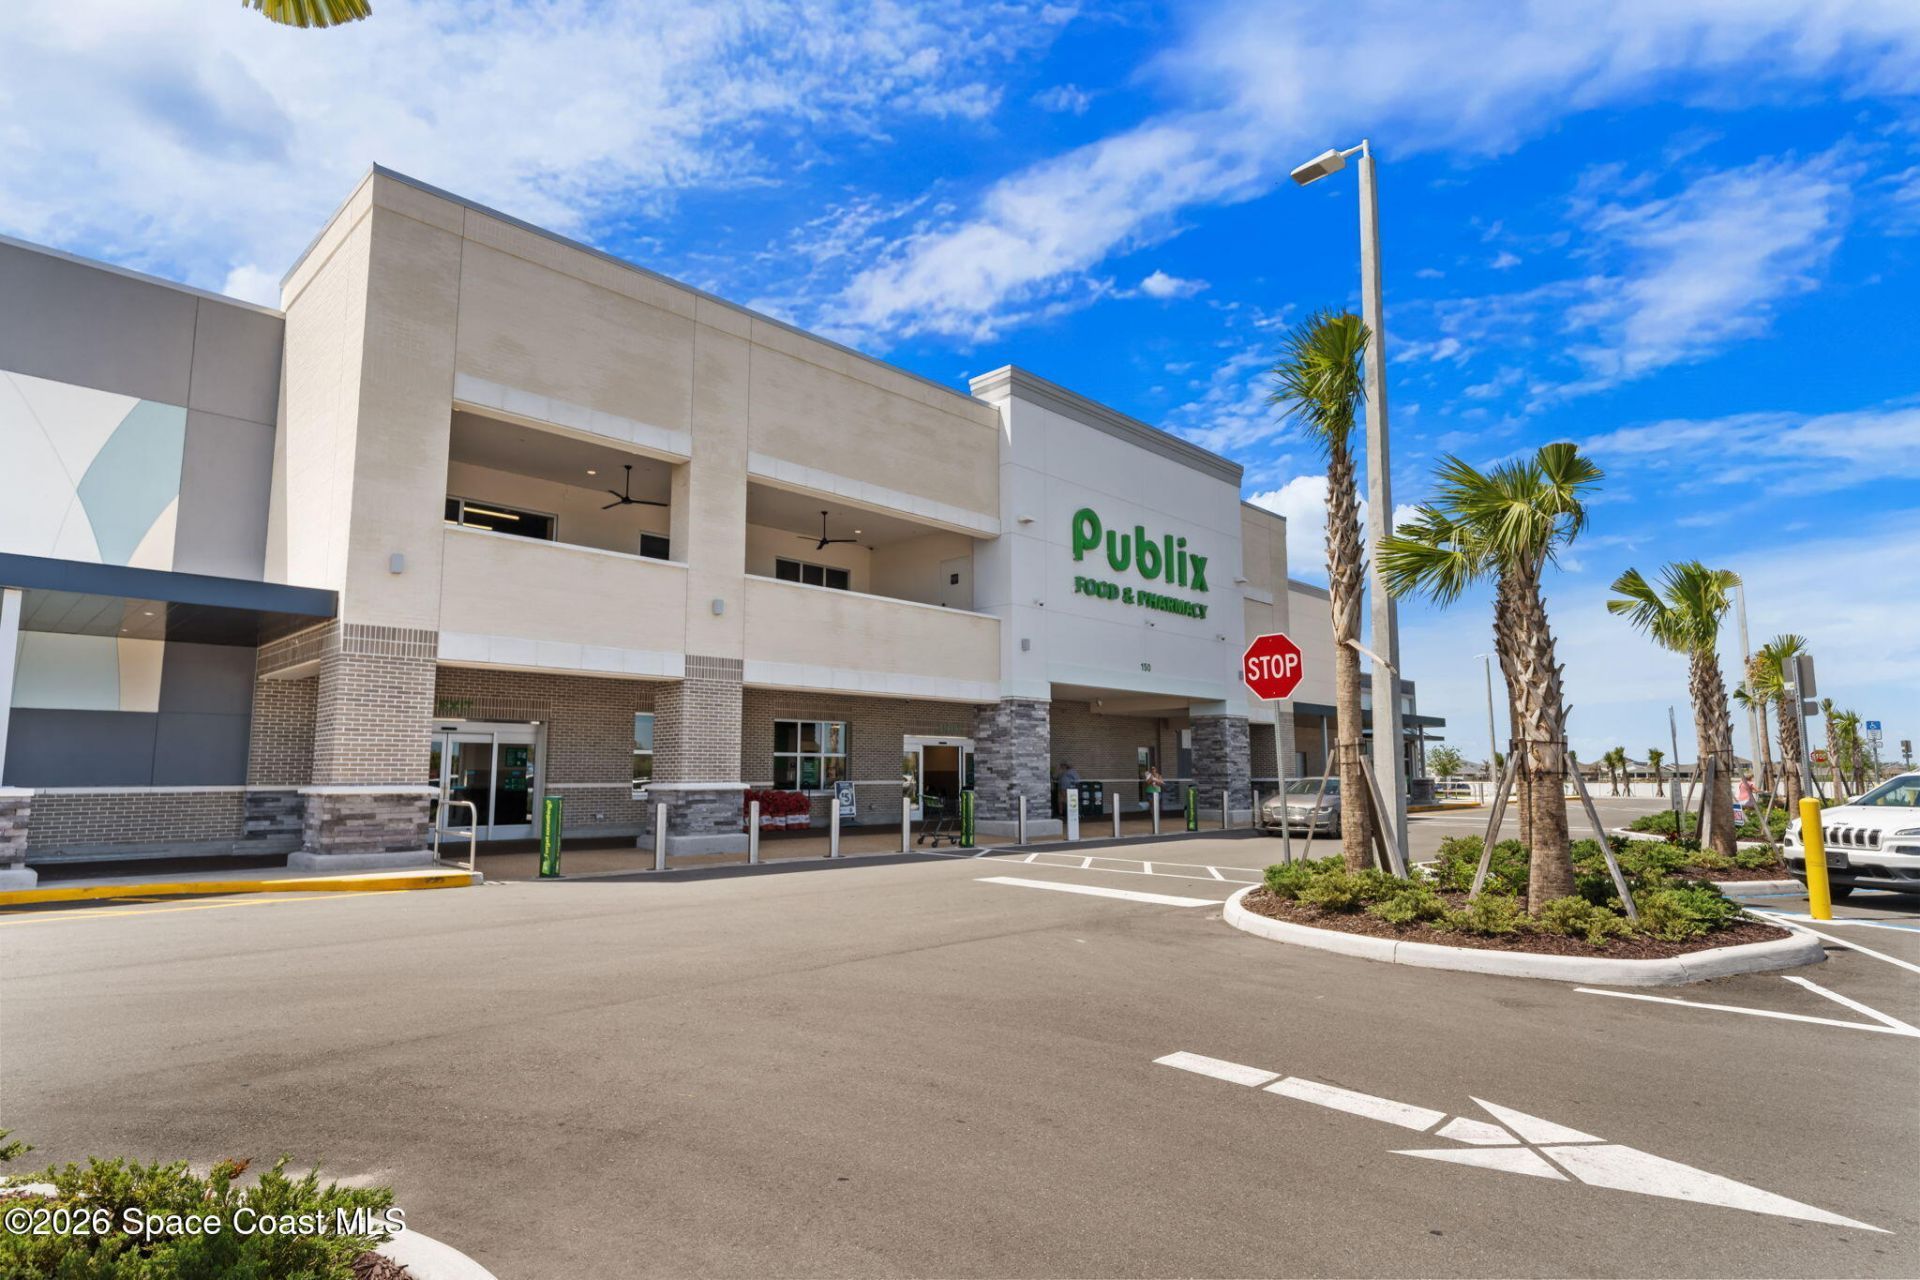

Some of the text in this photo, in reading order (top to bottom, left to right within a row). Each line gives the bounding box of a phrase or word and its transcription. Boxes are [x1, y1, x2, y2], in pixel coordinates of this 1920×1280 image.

[1072, 507, 1209, 592] Publix
[1074, 576, 1208, 619] FOOD & PHARMACY
[1248, 653, 1298, 681] STOP
